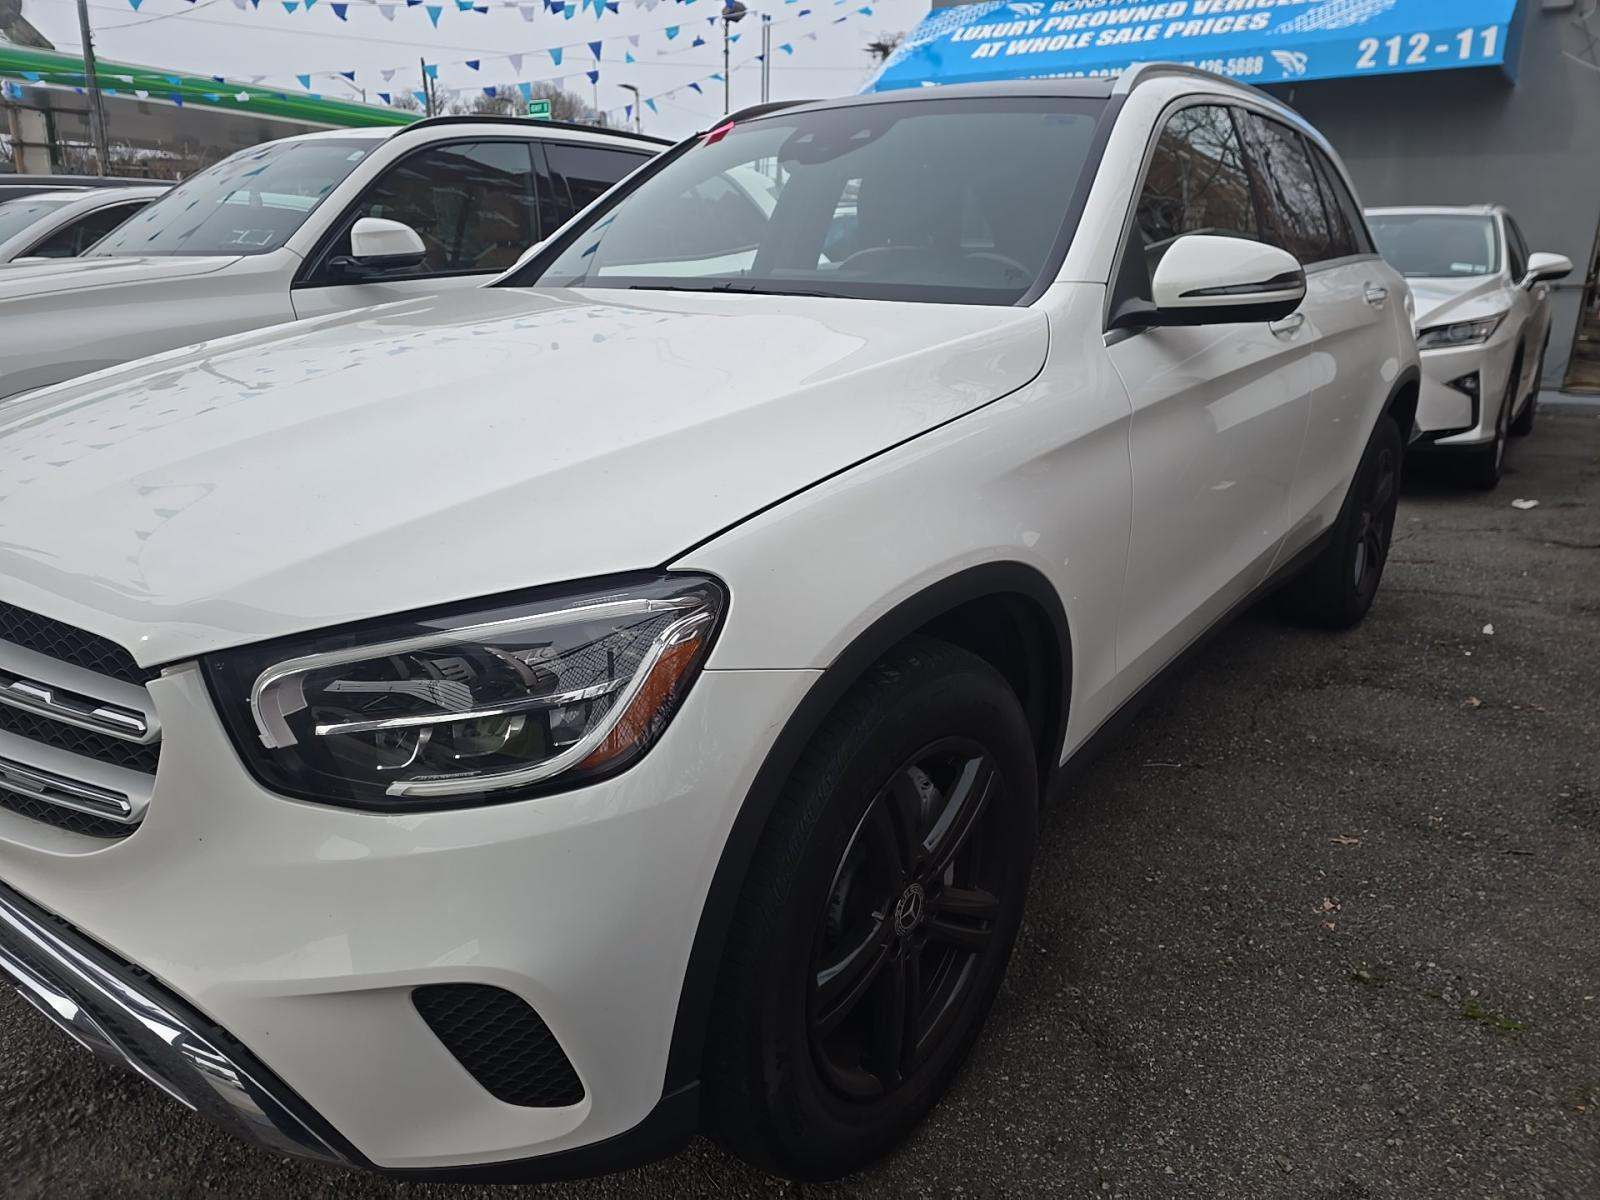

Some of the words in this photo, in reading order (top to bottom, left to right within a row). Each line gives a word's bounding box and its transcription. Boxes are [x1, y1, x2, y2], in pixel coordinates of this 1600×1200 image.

[951, 18, 1044, 42] LUXURY
[1042, 1, 1188, 33] PREOWNED
[1192, 0, 1320, 15] VEHIC
[971, 41, 1007, 59] AT
[1005, 31, 1095, 56] WHOLE
[1095, 24, 1162, 46] SALE
[1164, 12, 1271, 39] PRICES
[1355, 25, 1499, 69] 212-11
